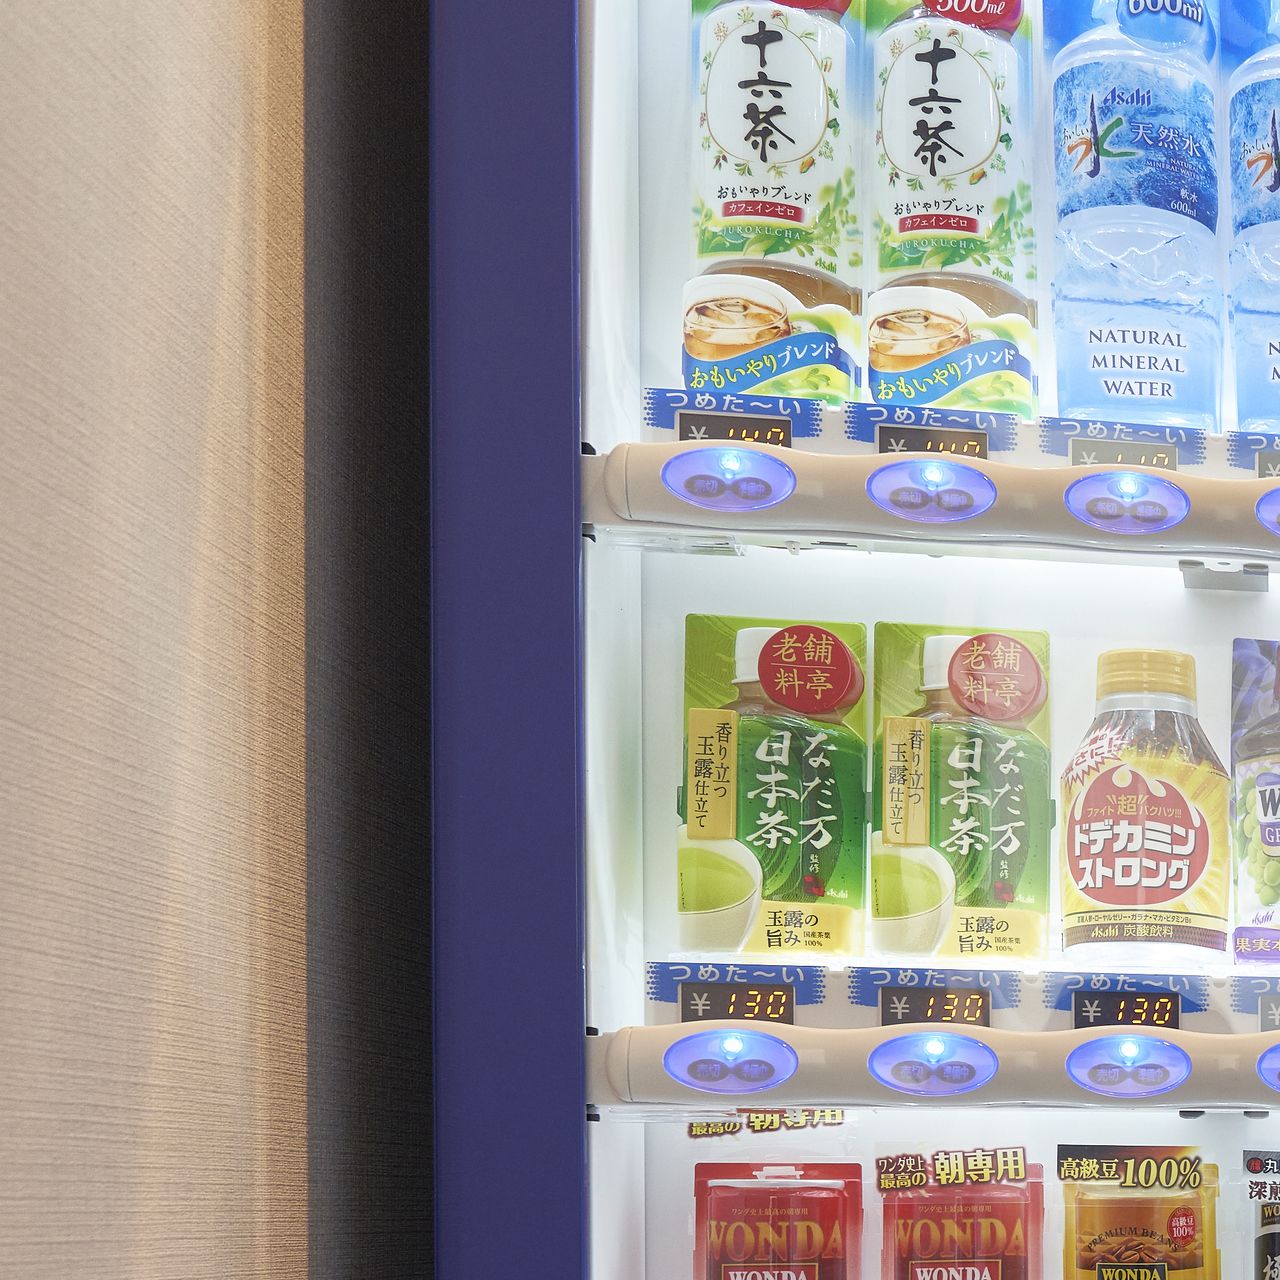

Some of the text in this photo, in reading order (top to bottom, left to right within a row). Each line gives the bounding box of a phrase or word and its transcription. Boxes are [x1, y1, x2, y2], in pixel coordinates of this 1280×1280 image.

[738, 20, 795, 163] 十六茶
[909, 38, 964, 177] 十六茶
[1103, 87, 1151, 107] Asahi
[1130, 121, 1201, 157] 天然水
[717, 186, 812, 204] おもいやりブレンド
[729, 203, 795, 217] カフェインゼロ
[722, 226, 801, 240] JUROKUCHA
[1089, 329, 1187, 348] NATURAL
[689, 341, 836, 390] おもいやりブレンド
[1092, 354, 1185, 373] MINERAL
[1103, 380, 1174, 397] WATER
[771, 632, 835, 666] 老舗
[774, 668, 834, 700] 料亭
[713, 722, 732, 799] 香り立つ
[694, 735, 715, 829] 玉露仕立て
[746, 730, 800, 850] 日本茶
[799, 732, 837, 850] なだ万
[1074, 819, 1196, 857] ドデカミン
[1078, 857, 1191, 891] ストロング
[765, 909, 819, 928] 玉露の
[1091, 924, 1174, 939] Asahi 炭酸飲料
[766, 929, 802, 949] 旨み
[878, 1157, 924, 1173] ワンダ史上
[879, 1171, 927, 1190] 最高の
[934, 1147, 1026, 1184] 朝専用
[1059, 1157, 1201, 1190] 高級豆100%
